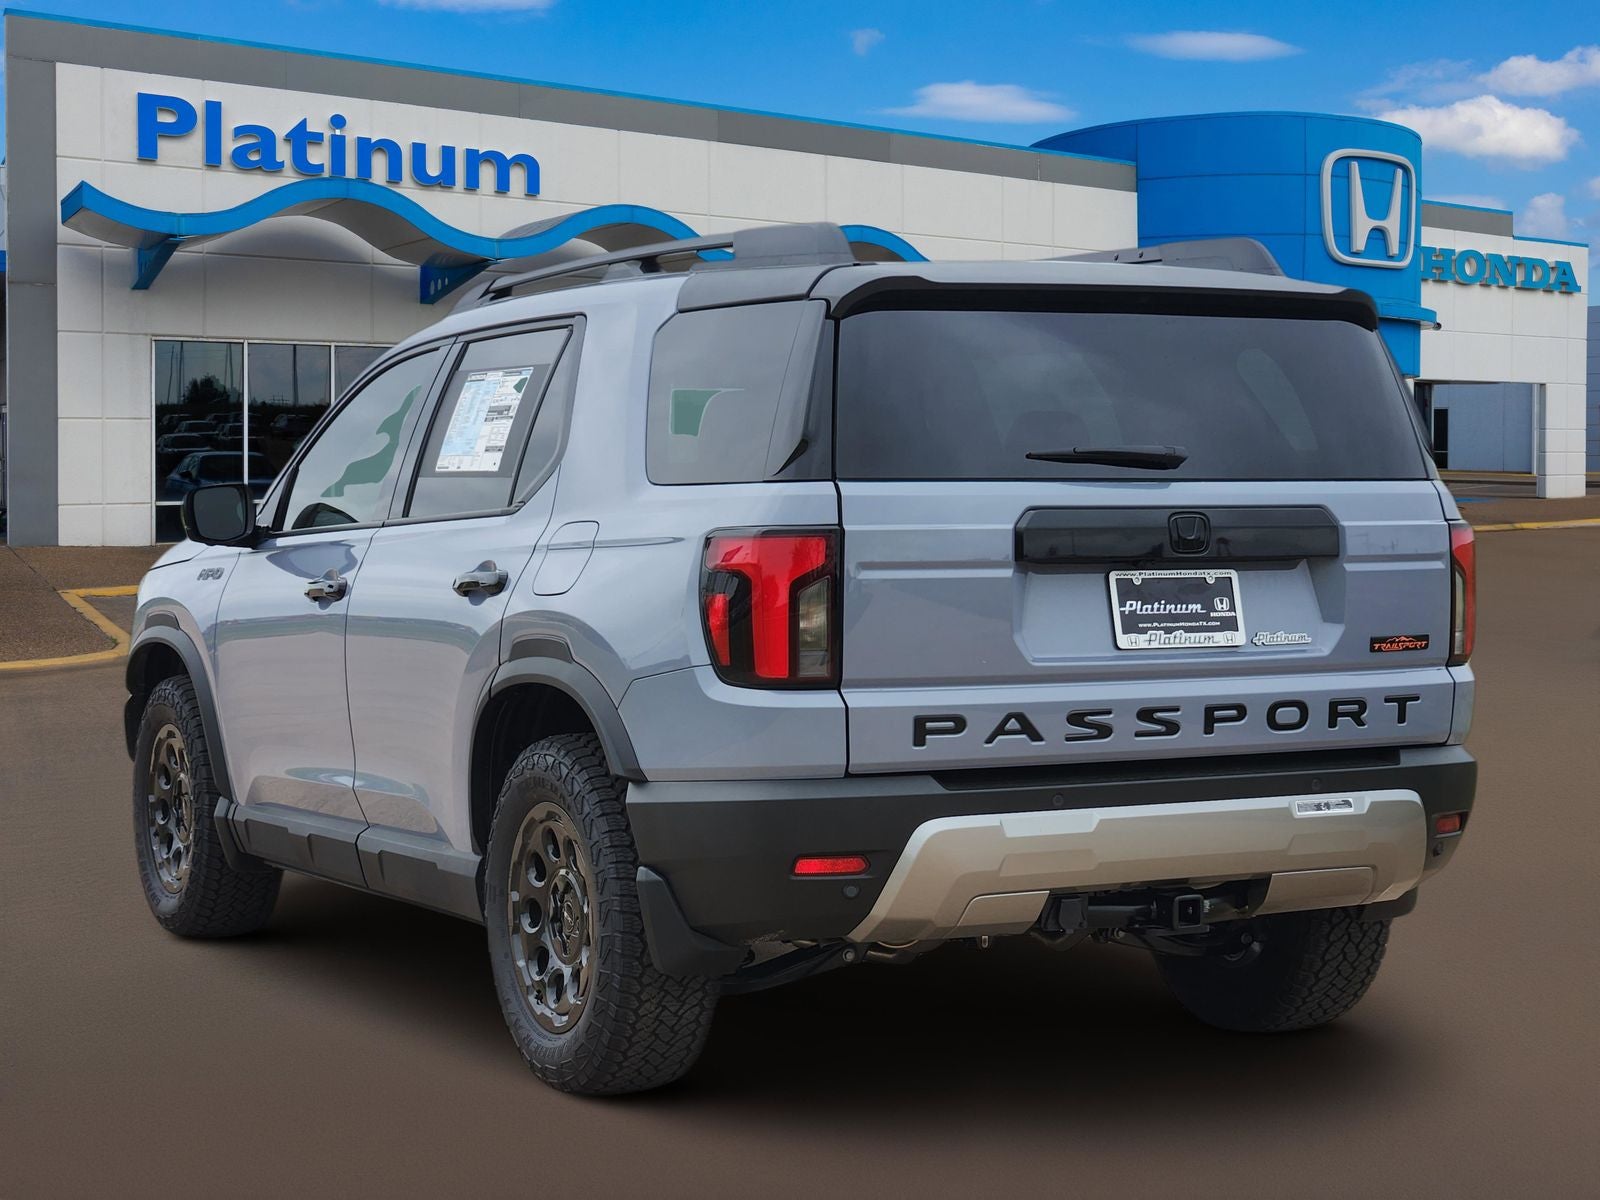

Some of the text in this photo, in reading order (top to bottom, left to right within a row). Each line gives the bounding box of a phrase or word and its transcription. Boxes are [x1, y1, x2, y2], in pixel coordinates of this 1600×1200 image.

[137, 92, 540, 196] Platinum
[1421, 246, 1582, 293] HONDA
[1120, 600, 1206, 614] Platinum
[1144, 630, 1220, 646] Platinum
[1253, 631, 1312, 646] Platinum
[1373, 640, 1428, 652] TRAILSPORT
[912, 695, 1421, 747] PASSPORT
